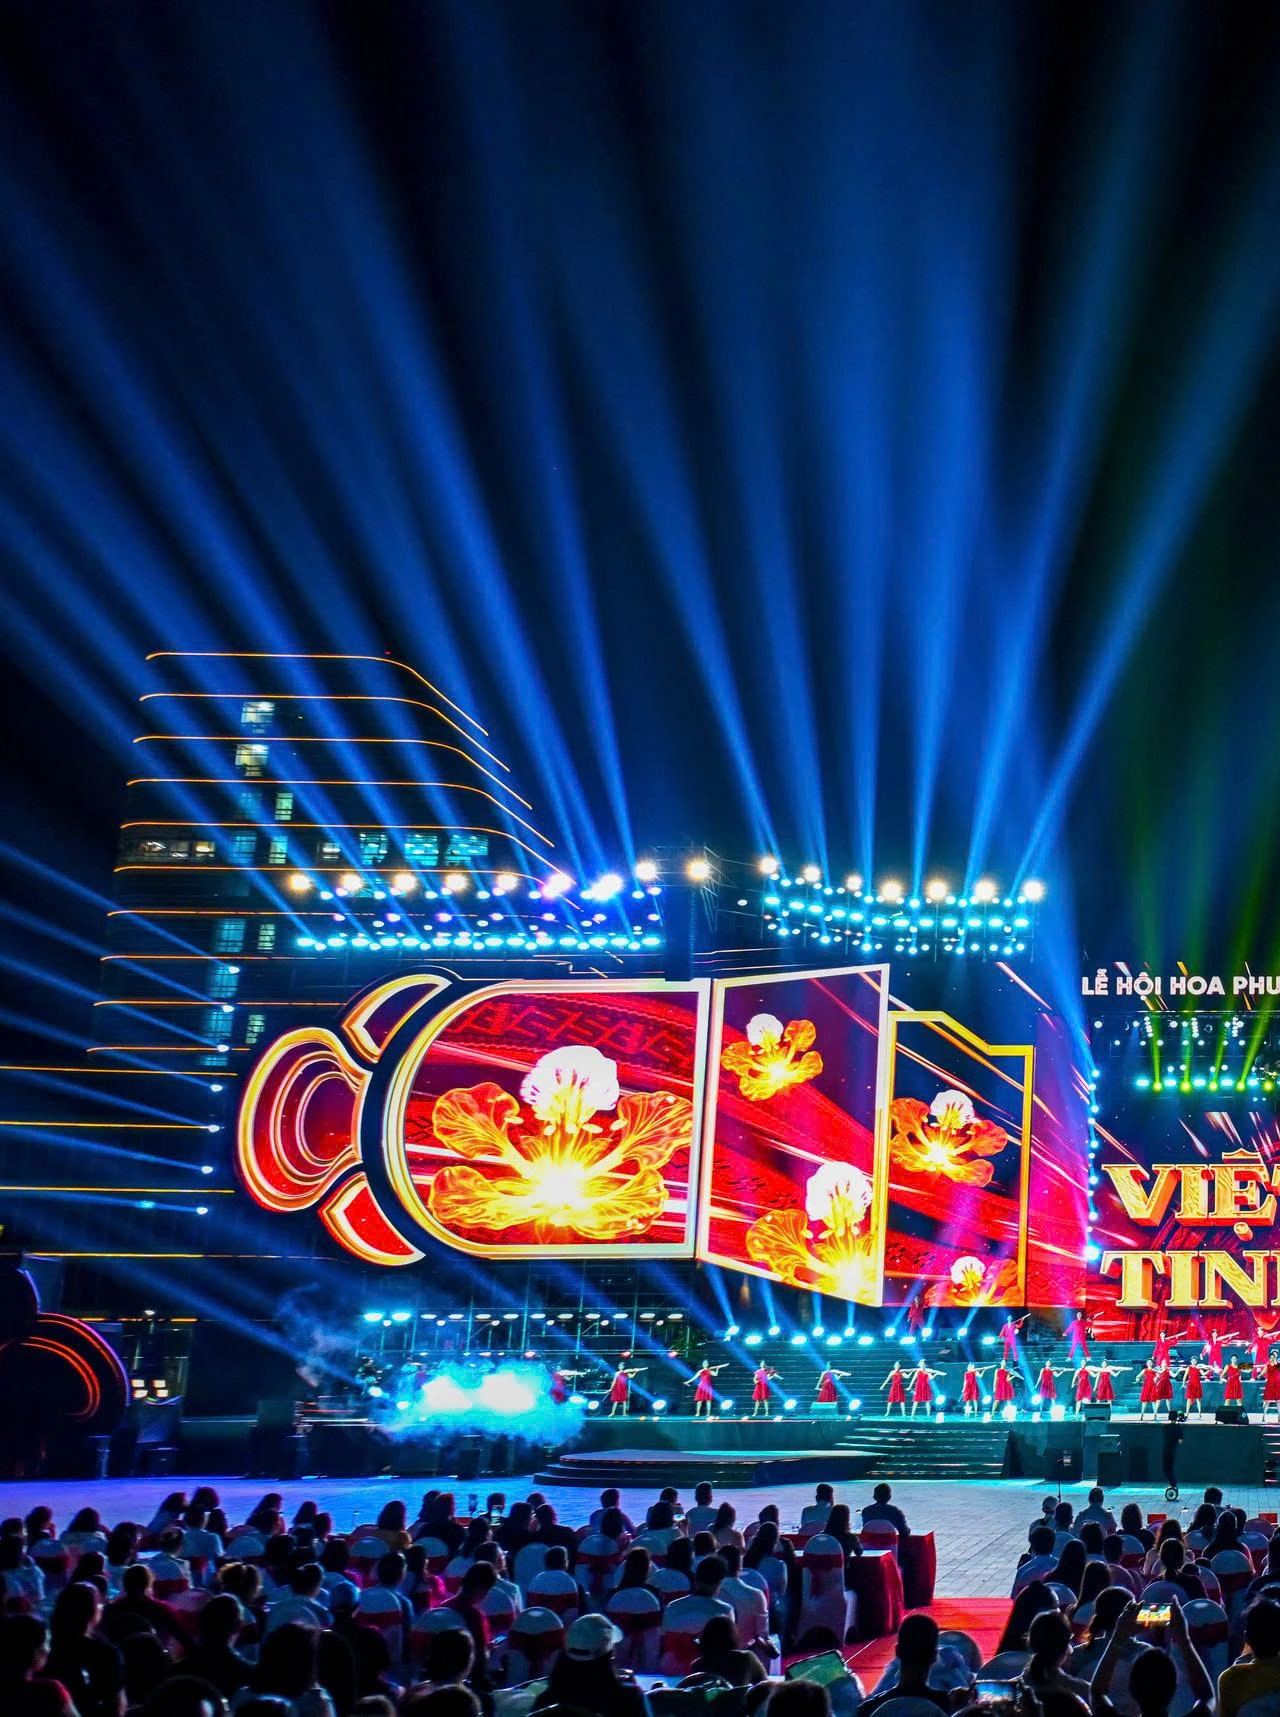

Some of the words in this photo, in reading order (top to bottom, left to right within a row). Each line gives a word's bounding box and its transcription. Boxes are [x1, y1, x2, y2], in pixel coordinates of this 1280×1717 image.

[1082, 969, 1108, 995] LỄ
[1116, 972, 1161, 1000] HỘI
[1170, 976, 1225, 995] HOA
